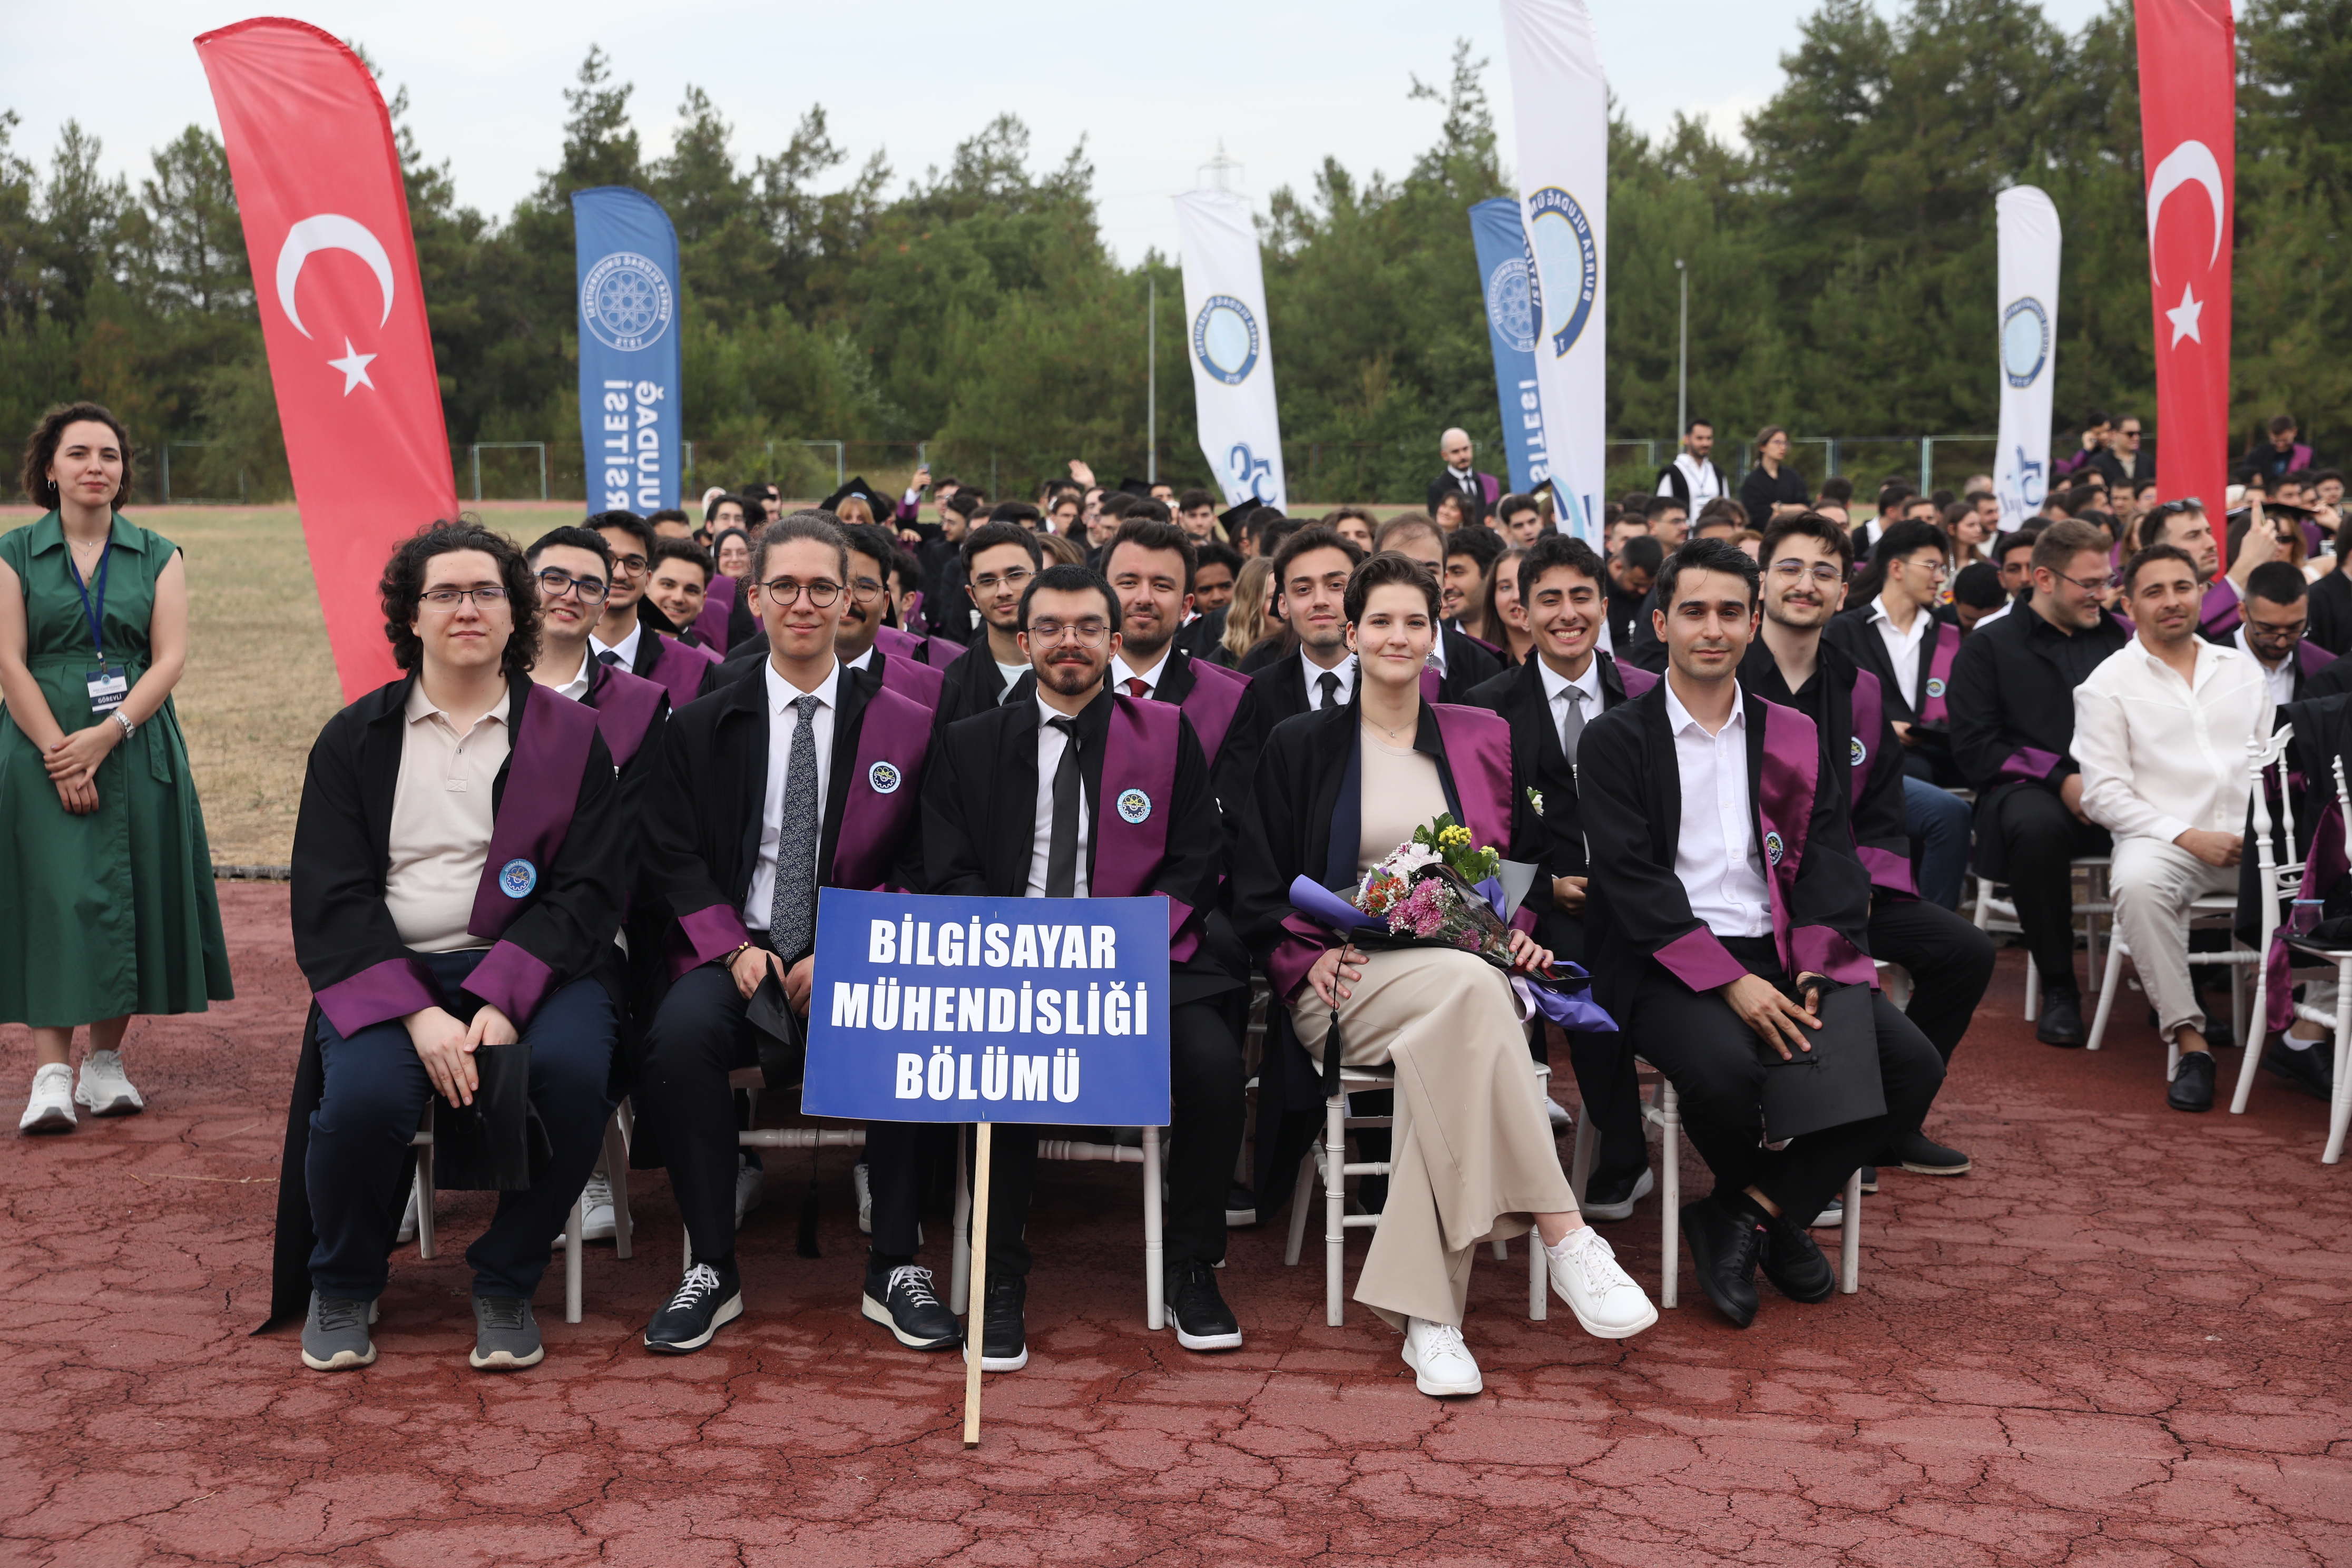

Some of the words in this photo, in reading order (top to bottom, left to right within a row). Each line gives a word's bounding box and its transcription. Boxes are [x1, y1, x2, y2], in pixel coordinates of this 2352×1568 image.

[97, 692, 122, 704] GÖREVLİ
[504, 861, 518, 872] ULUDAĞ
[868, 913, 1116, 969] BİLGİSAYAR
[831, 976, 1148, 1036] MÜHENDİSLİĞİ
[895, 1045, 1080, 1103] BÖLÜMÜ
